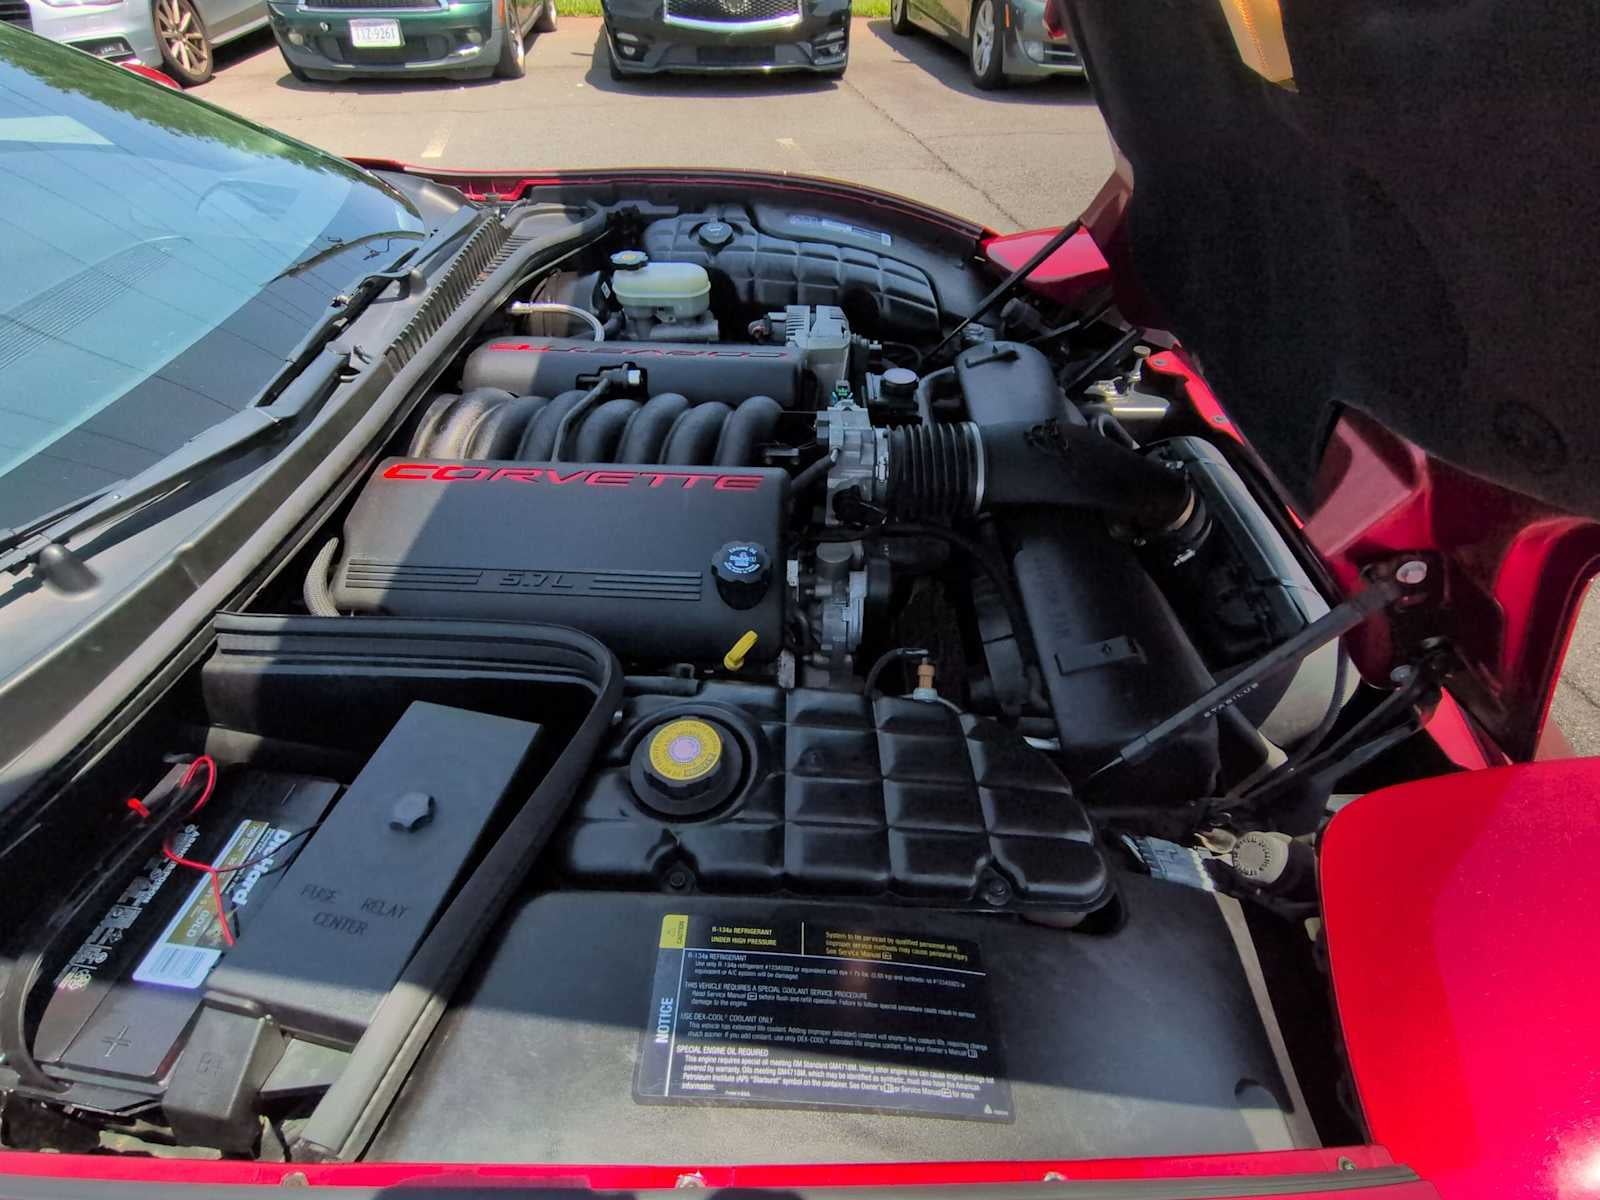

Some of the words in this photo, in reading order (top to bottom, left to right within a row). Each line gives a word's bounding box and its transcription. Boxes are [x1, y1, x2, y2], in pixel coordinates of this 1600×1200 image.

[383, 463, 766, 491] CORVETTE
[499, 573, 574, 588] 5.7L
[300, 884, 337, 904] FUSE
[360, 897, 409, 920] RELAY
[312, 911, 369, 936] CENTER
[733, 927, 772, 935] REFRIGERANT
[709, 953, 746, 961] REFRIGERANT
[722, 983, 750, 991] REQUIRES
[757, 985, 780, 993] SPECIAL
[782, 987, 808, 995] COOLANT
[656, 997, 674, 1043] NOTICE
[729, 1014, 756, 1022] COOLANT
[676, 1044, 701, 1053] SPECIAL
[702, 1045, 725, 1054] ENGINE
[726, 1046, 736, 1055] OIL
[737, 1047, 768, 1056] REQUIRED
